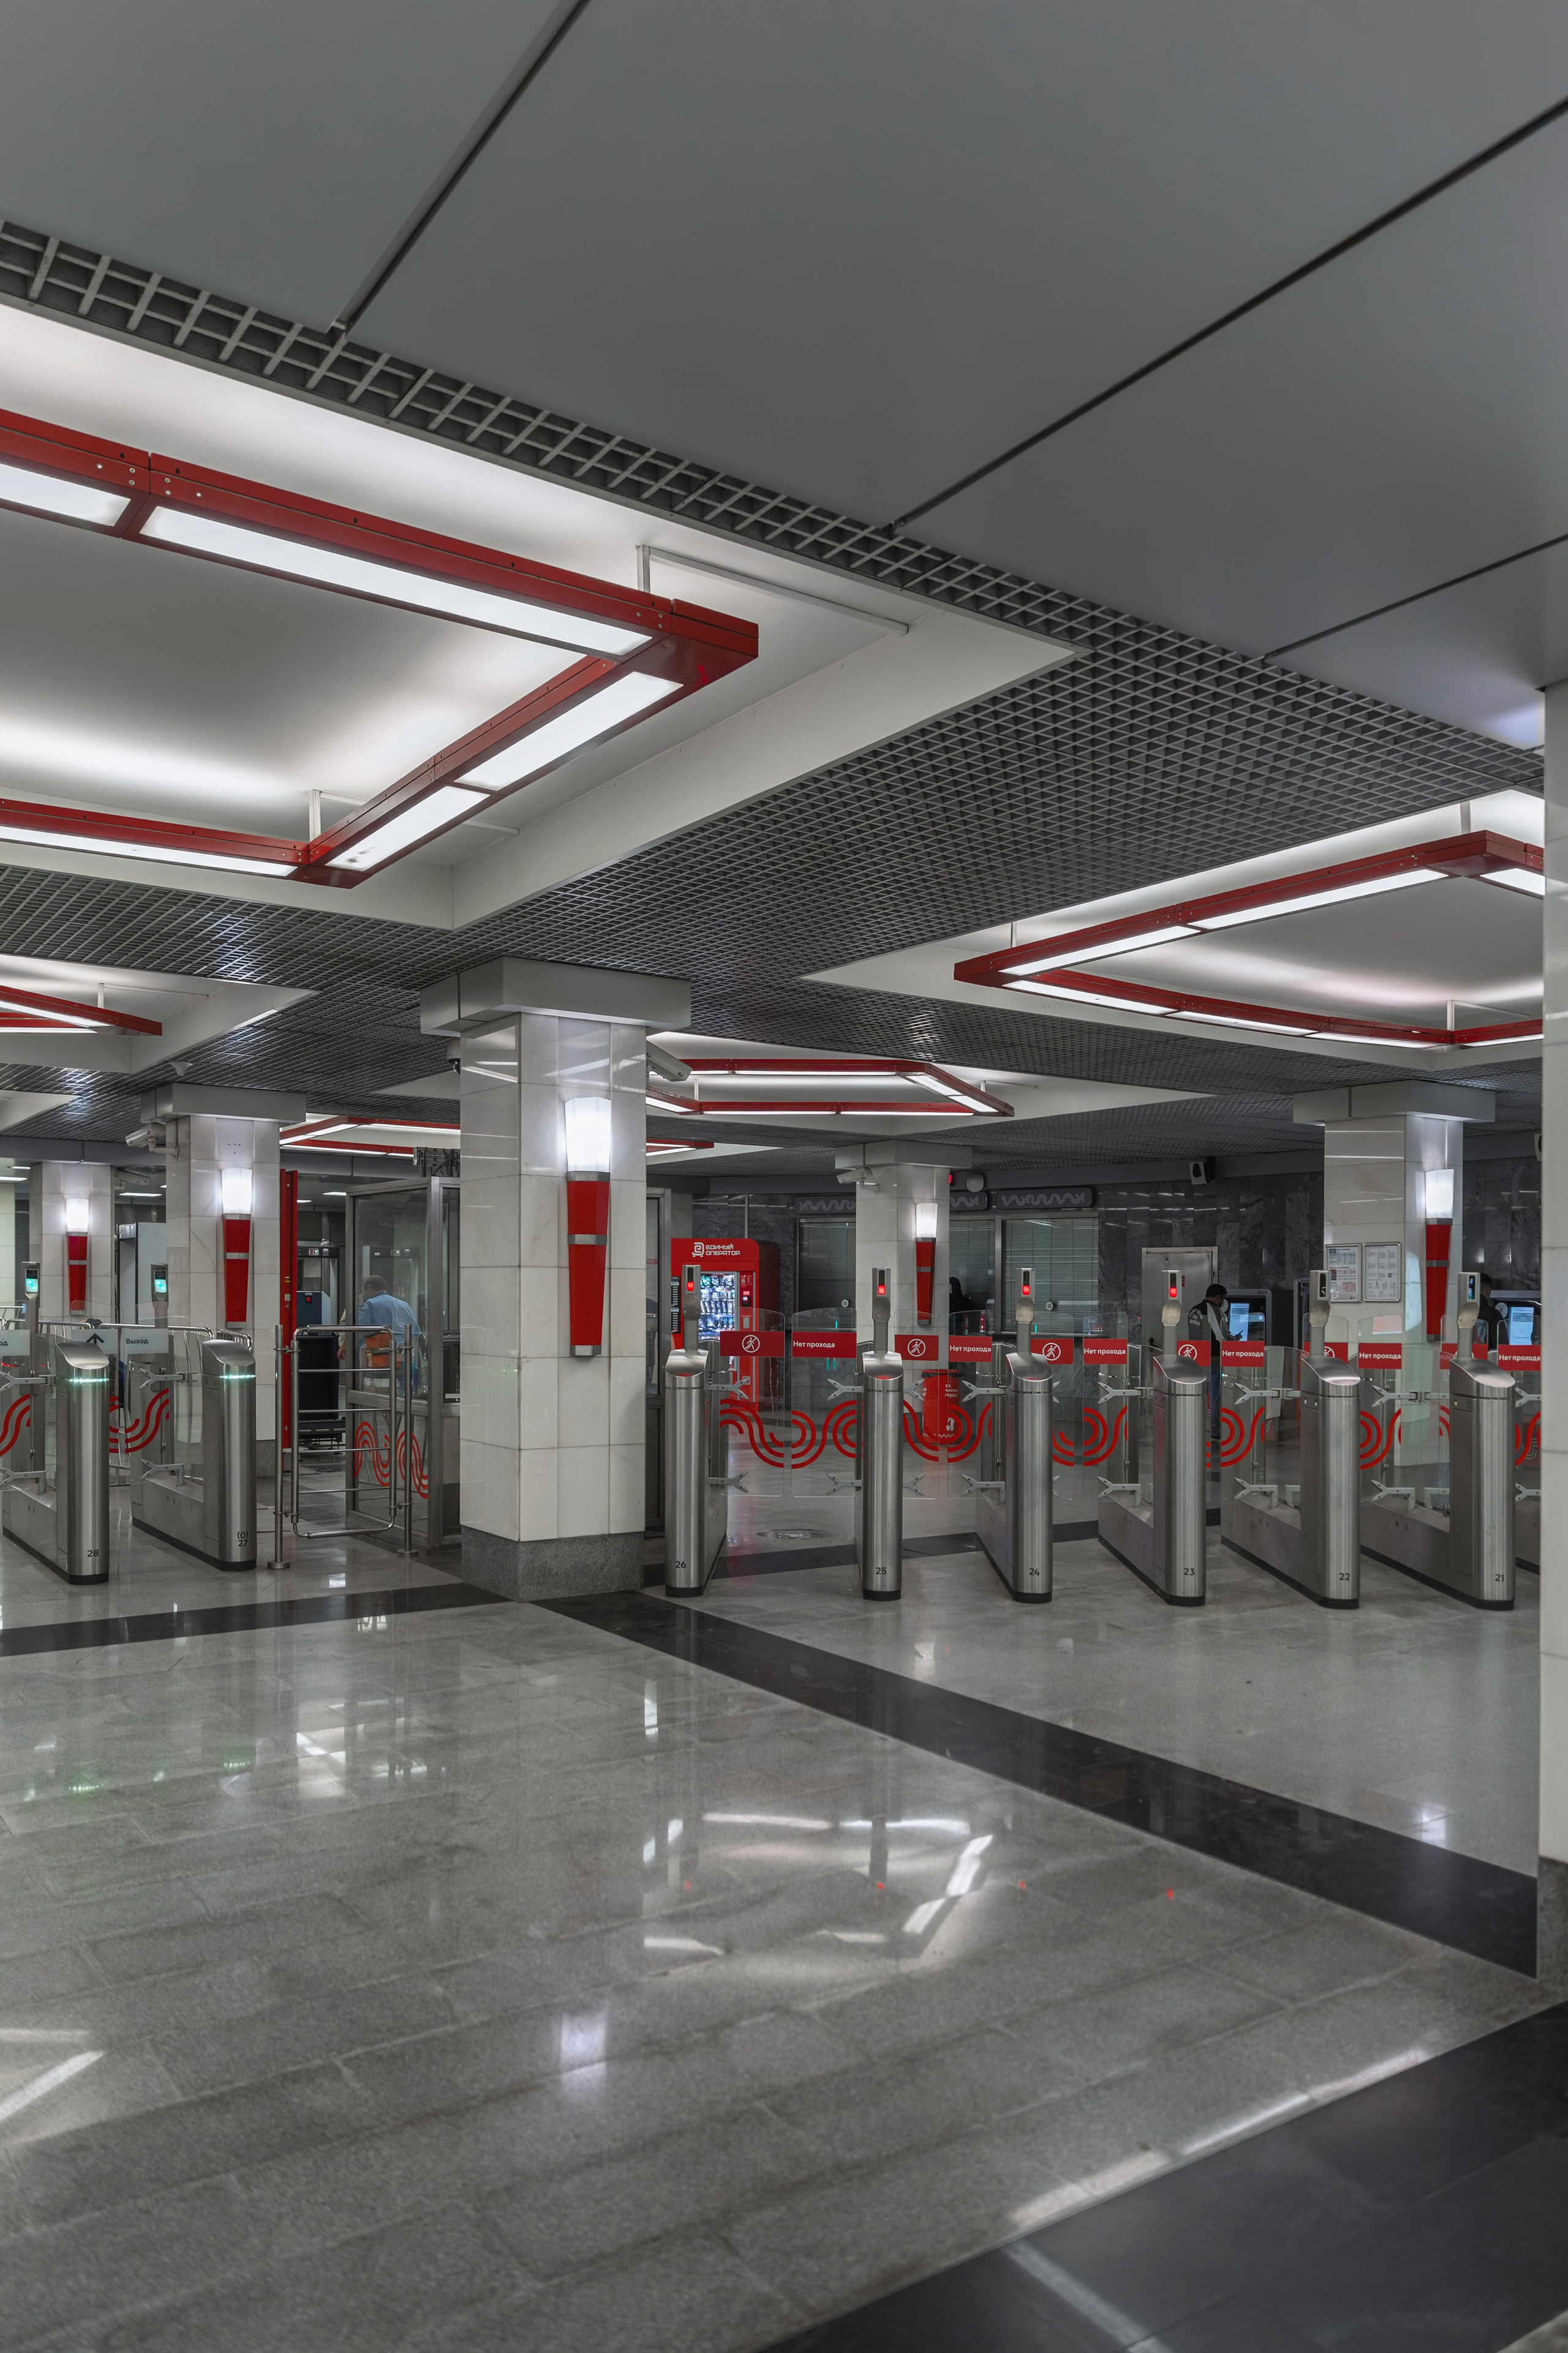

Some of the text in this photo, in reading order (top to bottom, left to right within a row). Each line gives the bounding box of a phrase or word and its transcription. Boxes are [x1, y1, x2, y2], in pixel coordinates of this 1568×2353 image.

[675, 1560, 686, 1569] 26
[1029, 1568, 1040, 1576] 24
[1339, 1573, 1351, 1581] 22
[1494, 1574, 1504, 1582] 21
